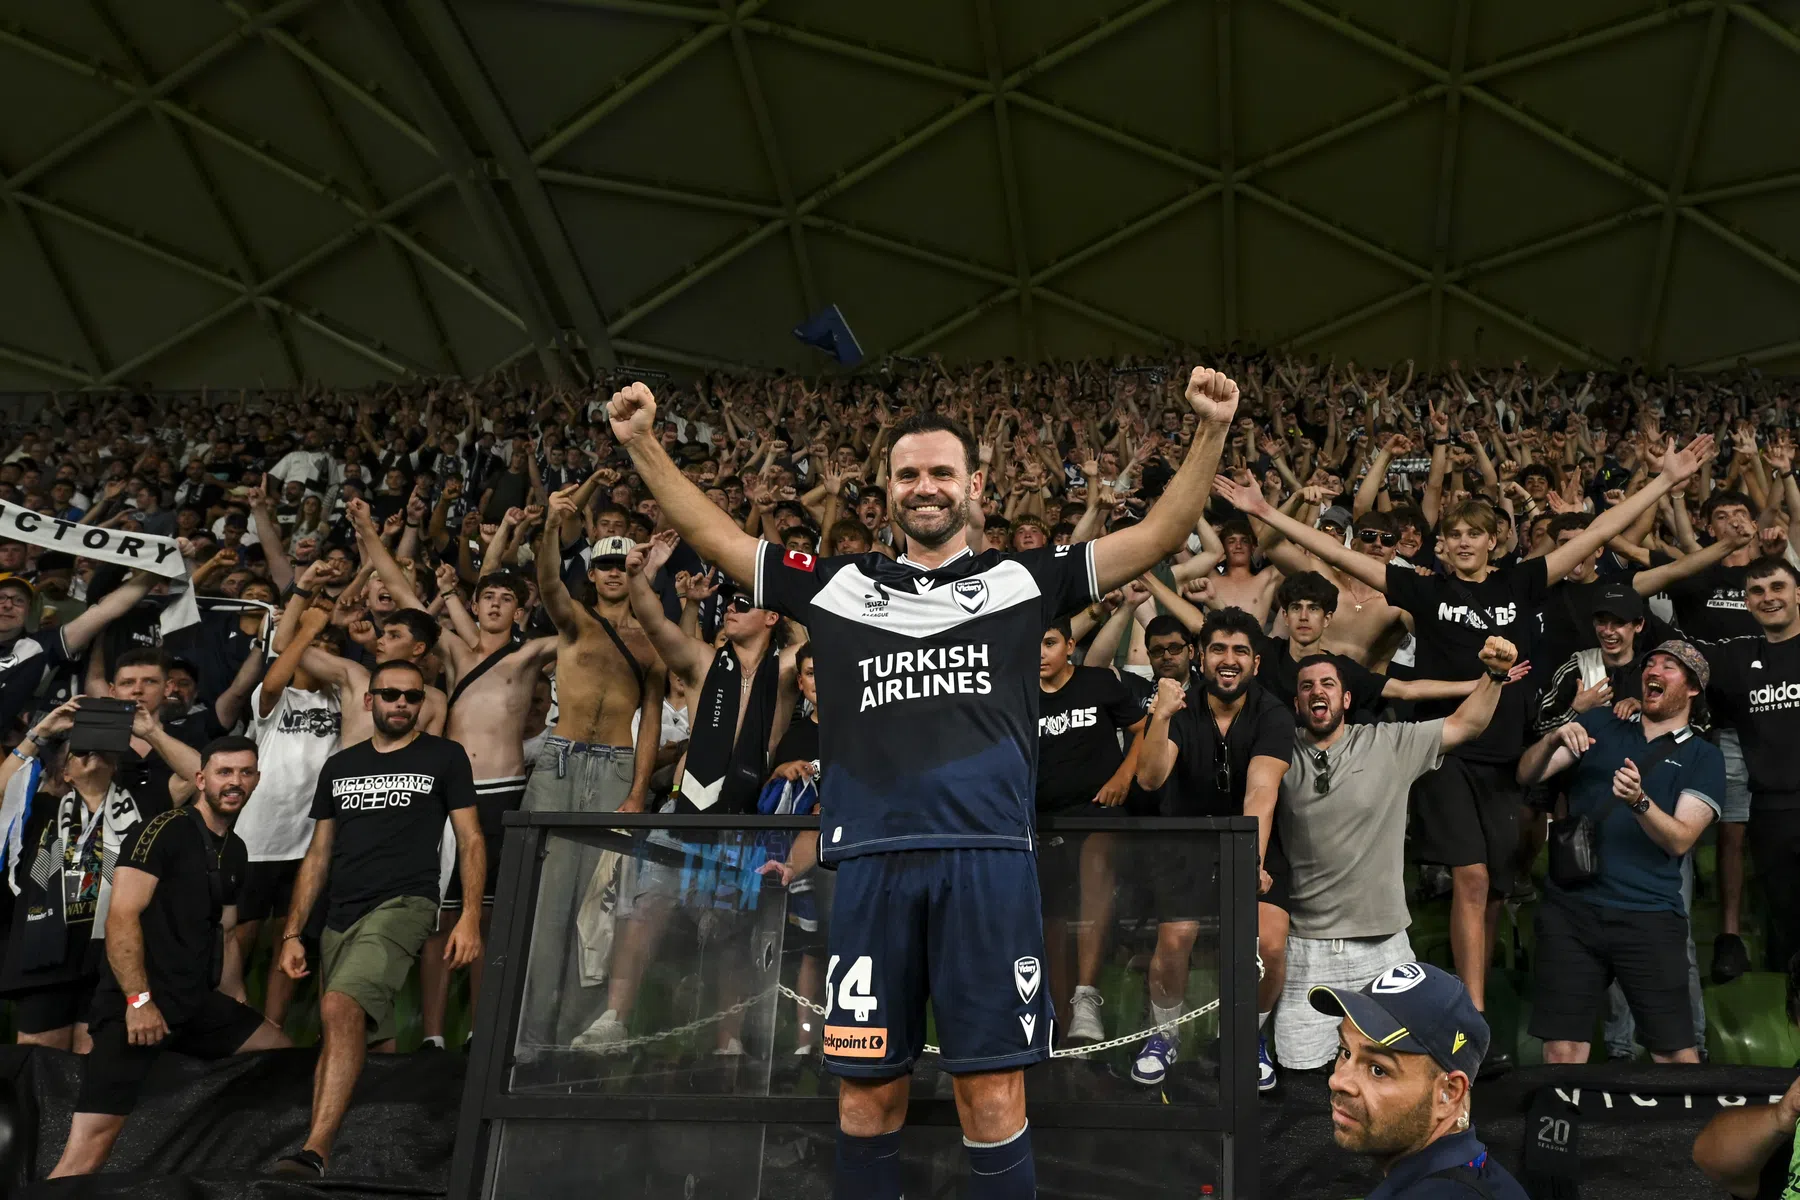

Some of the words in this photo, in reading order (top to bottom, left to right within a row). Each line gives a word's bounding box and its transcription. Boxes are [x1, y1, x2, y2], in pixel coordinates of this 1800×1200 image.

[864, 600, 888, 609] ISUZU
[858, 644, 989, 682] TURKISH
[712, 688, 724, 728] SEASONS
[860, 671, 992, 713] AIRLINES
[333, 775, 432, 795] MELBOURNE
[1538, 1116, 1570, 1145] 20
